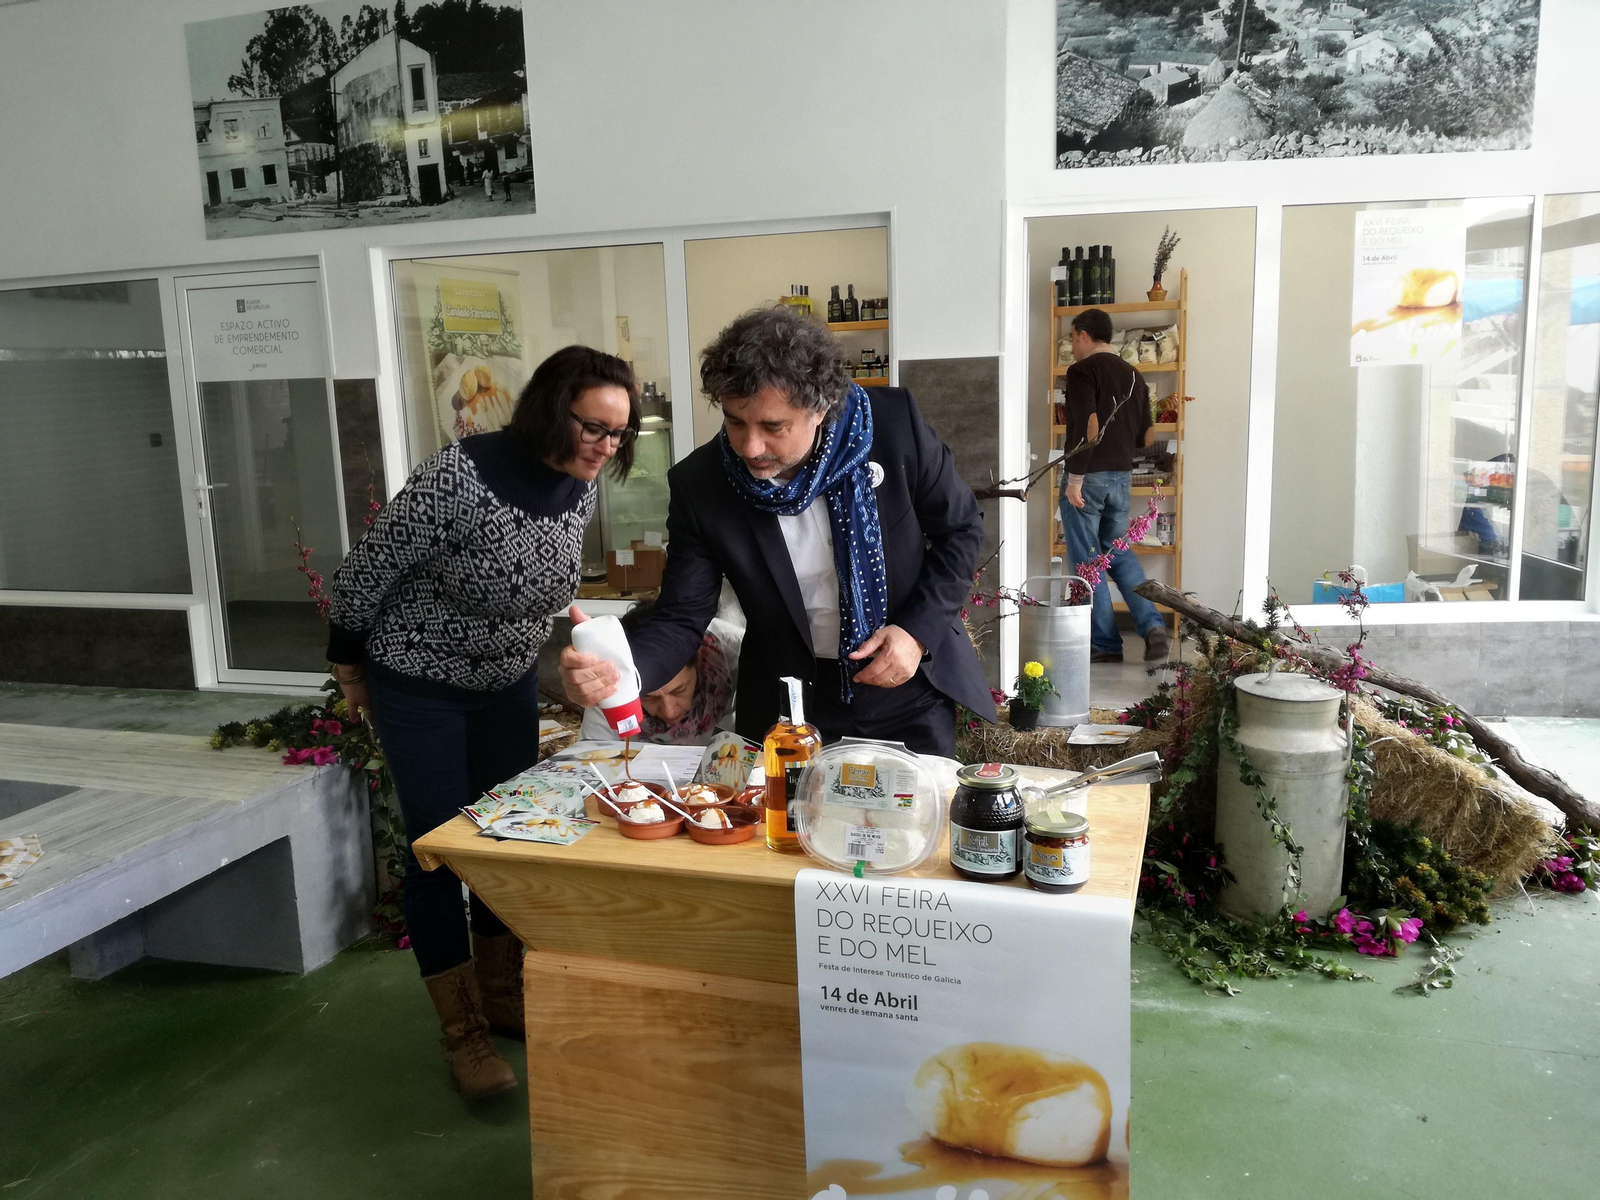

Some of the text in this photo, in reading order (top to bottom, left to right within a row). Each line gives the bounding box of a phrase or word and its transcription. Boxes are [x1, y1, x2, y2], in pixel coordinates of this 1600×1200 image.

[1362, 217, 1410, 226] XXVI FEIRA
[1362, 226, 1424, 236] DO REQUEIXO
[1370, 237, 1384, 245] DO
[1386, 236, 1404, 244] MEL
[1371, 254, 1380, 262] de
[220, 318, 290, 332] ESPAZO ACTIVO
[214, 331, 299, 344] DE EMPRENDEMENTO
[232, 344, 283, 356] COMERCIAL
[968, 833, 989, 848] Mel
[816, 880, 952, 912] XXVI FEIRA
[817, 908, 993, 944] DO REQUEIXO
[818, 935, 937, 967] E DO MEL
[818, 962, 839, 971] Festa
[841, 965, 851, 973] de
[853, 966, 884, 976] Interese
[922, 974, 932, 982] de
[934, 976, 961, 985] Galicia
[821, 985, 918, 1010] 14 de Abril
[820, 1004, 918, 1022] venres de semana santa
